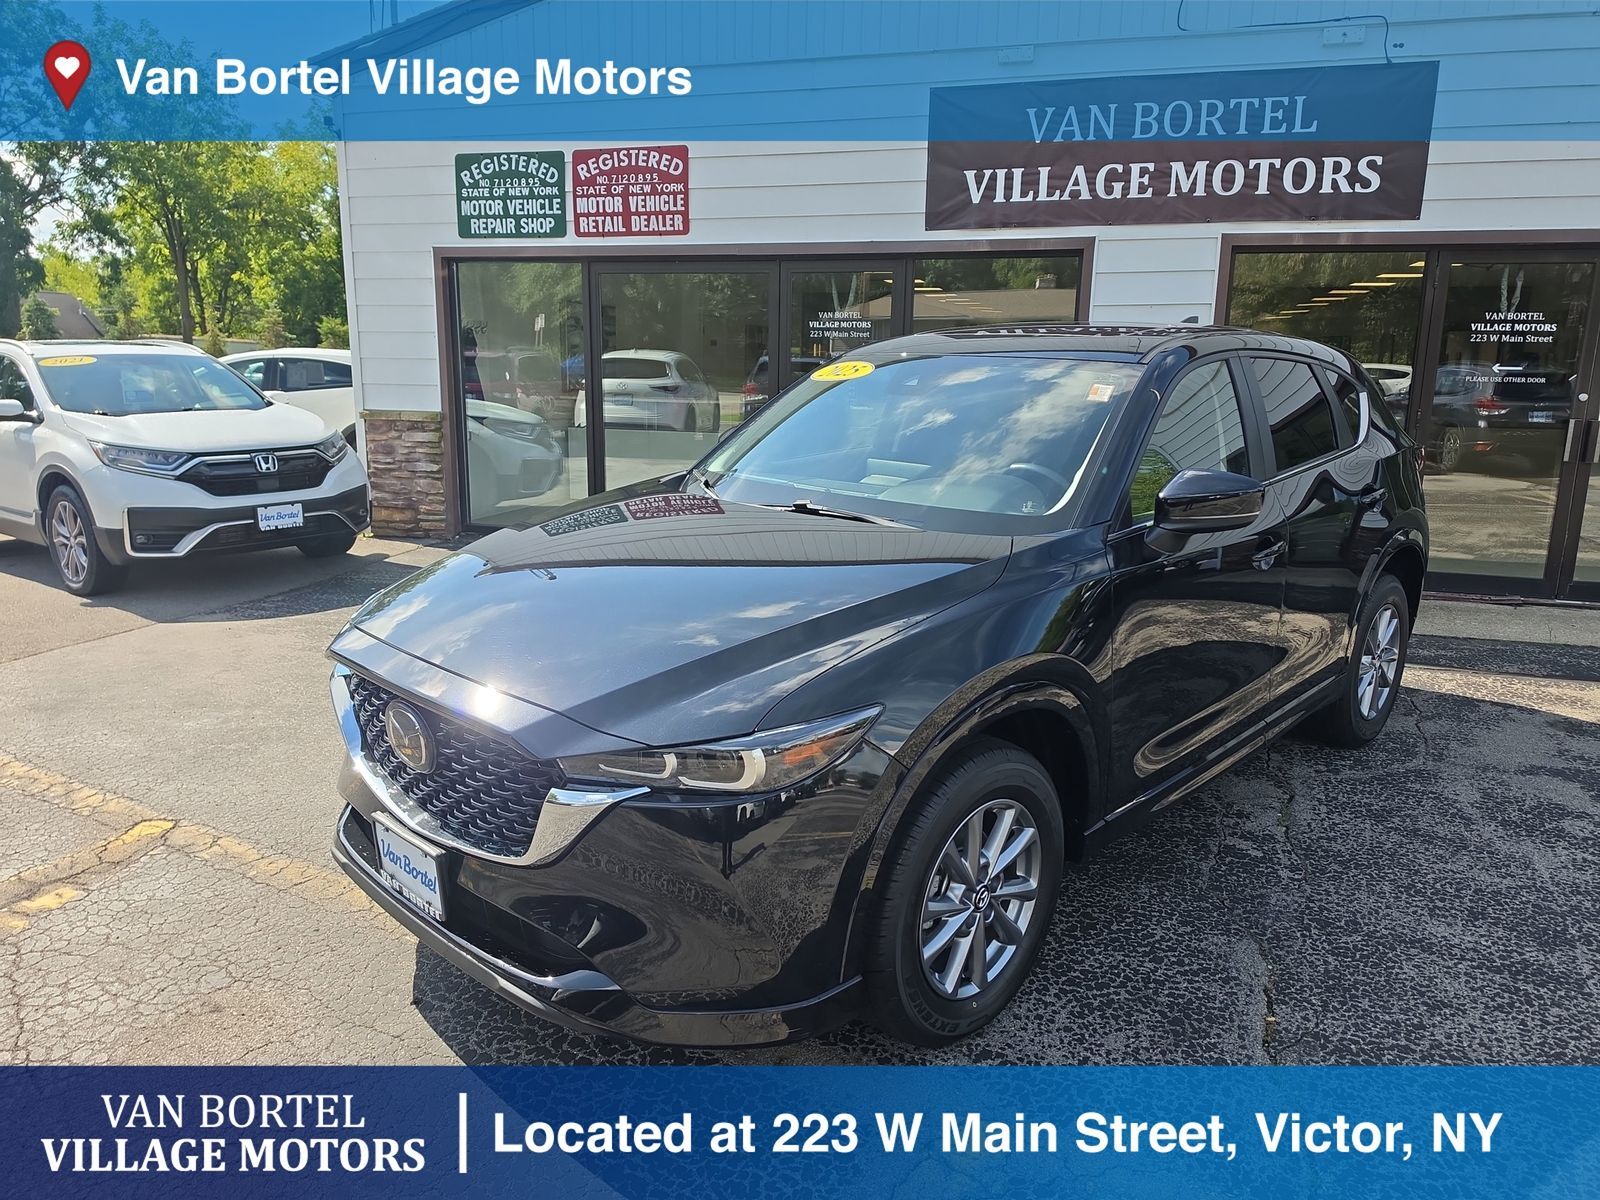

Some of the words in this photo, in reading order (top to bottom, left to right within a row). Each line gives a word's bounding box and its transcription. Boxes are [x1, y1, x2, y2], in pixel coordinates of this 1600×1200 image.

[1026, 104, 1118, 143] VAN
[1132, 96, 1318, 138] BORTEL
[460, 154, 559, 187] REGISTERED
[576, 150, 684, 180] REGISTERED
[493, 178, 541, 187] 7120895
[611, 173, 659, 183] 7120895
[963, 163, 1155, 203] VILLAGE
[1167, 156, 1383, 197] MOTORS
[461, 188, 490, 197] STATE
[493, 188, 505, 196] OF
[508, 187, 530, 196] NEW
[532, 187, 559, 195] YORK
[576, 186, 607, 195] STATE
[611, 185, 625, 194] OF
[629, 184, 652, 193] NEW
[655, 183, 685, 192] YORK
[461, 200, 504, 216] MOTOR
[507, 199, 561, 215] VEHICLE
[576, 197, 623, 214] MOTOR
[628, 194, 685, 212] VEHICLE
[470, 218, 516, 234] REPAIR
[520, 218, 555, 233] SHOP
[579, 216, 626, 232] RETAIL
[632, 215, 684, 231] DEALER
[1485, 312, 1505, 320] VAN
[1507, 312, 1546, 320] BORTEL
[1471, 323, 1512, 331] VILLAGE
[1514, 323, 1558, 332] MOTORS
[1470, 334, 1488, 342] 223
[1490, 334, 1500, 342] W
[1501, 334, 1524, 342] Main
[1526, 334, 1554, 342] Street
[260, 513, 275, 521] Van
[276, 511, 299, 520] Bortel
[380, 838, 403, 869] Van
[402, 854, 437, 894] Bortel
